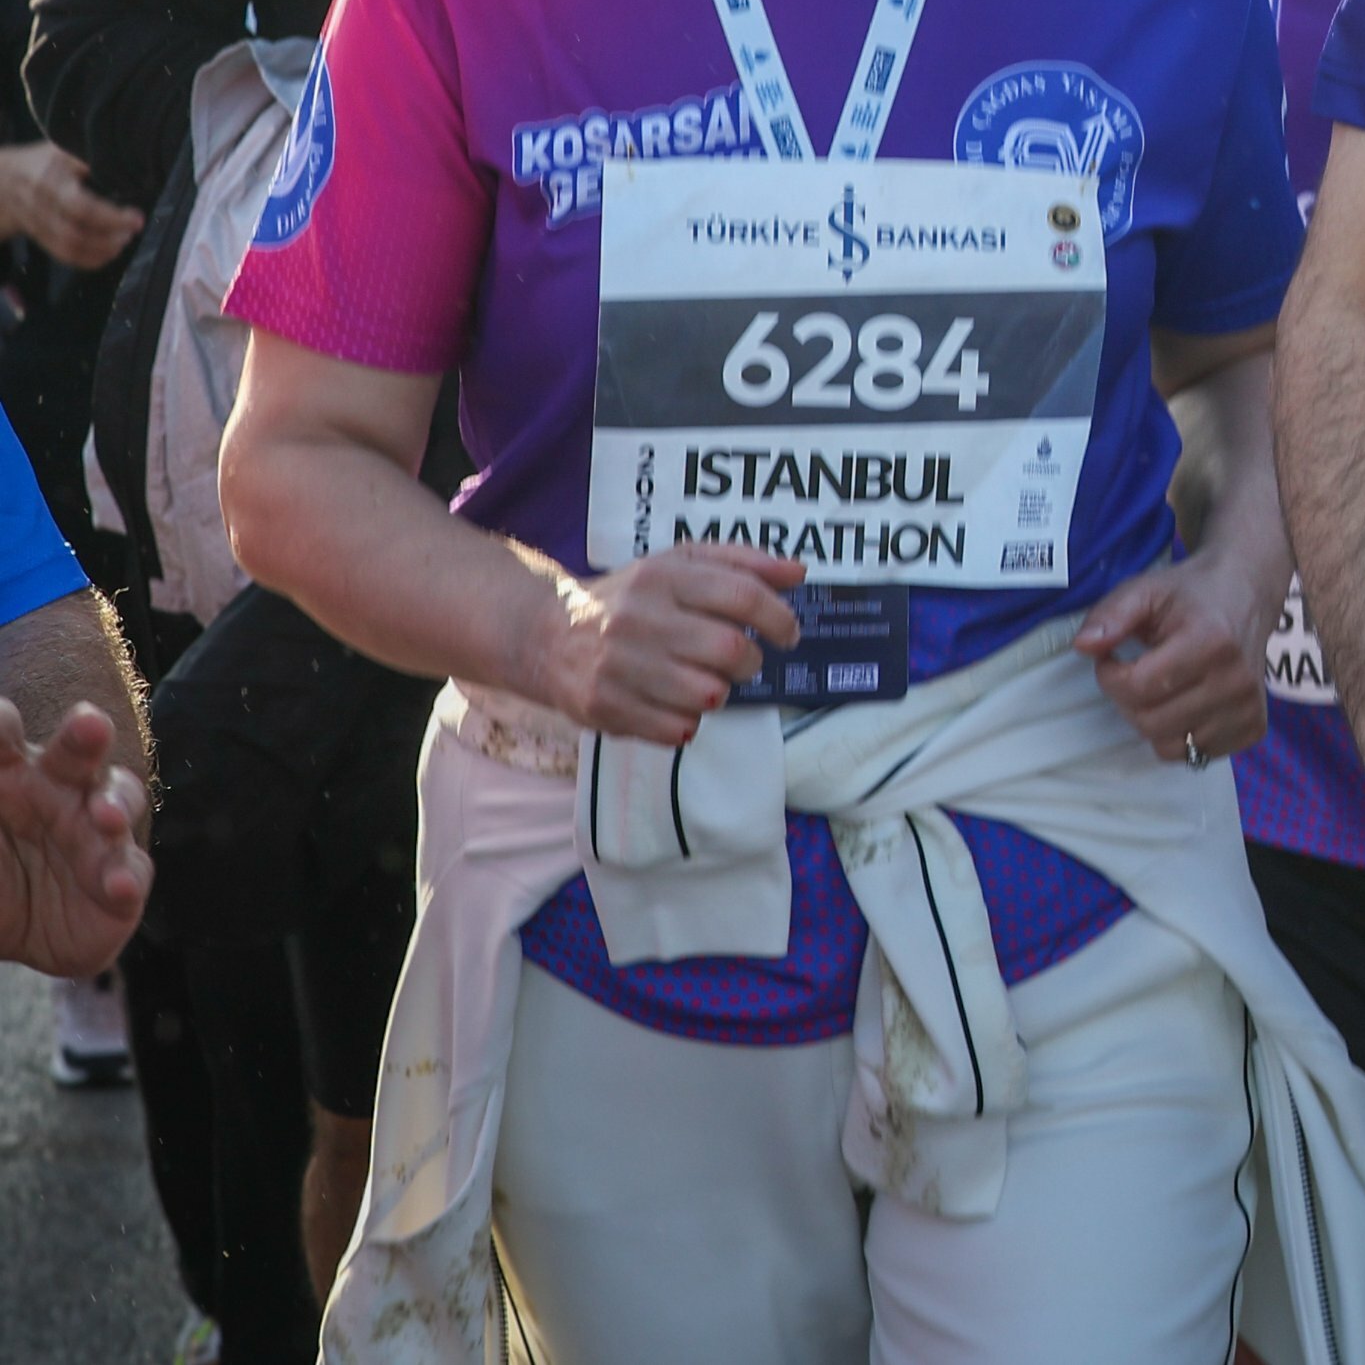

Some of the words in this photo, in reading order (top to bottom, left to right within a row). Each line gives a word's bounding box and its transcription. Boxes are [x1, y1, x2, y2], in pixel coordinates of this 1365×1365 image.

[688, 214, 820, 247] TÜRKİYE
[876, 223, 1006, 252] BANKASI
[722, 311, 990, 411] 6284
[683, 446, 964, 506] ISTANBUL
